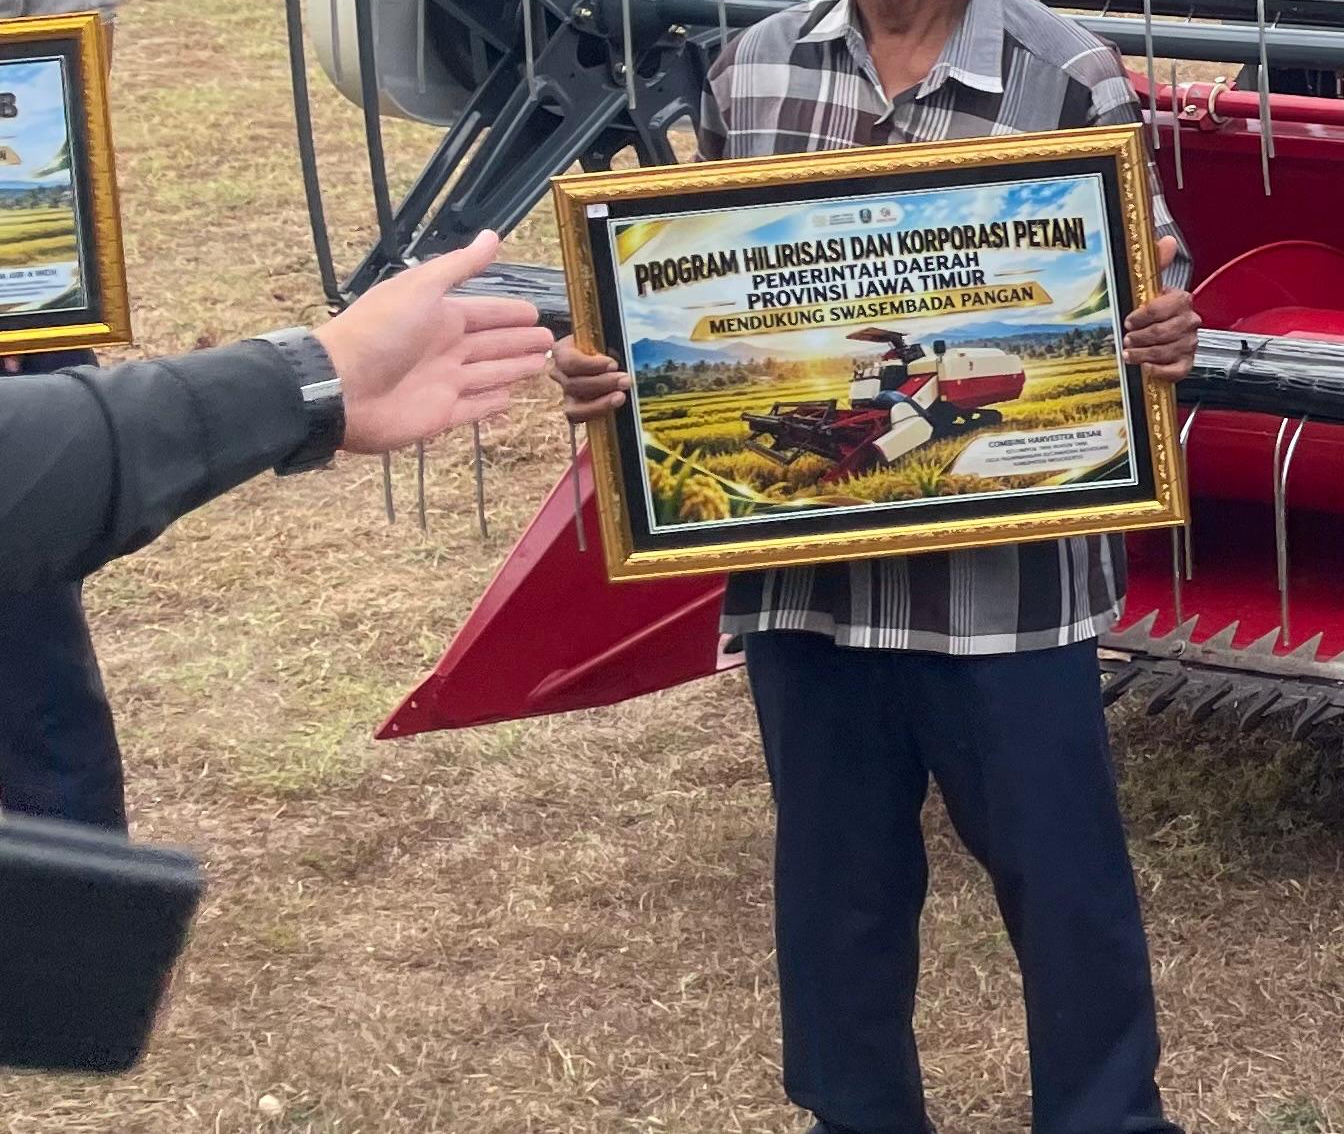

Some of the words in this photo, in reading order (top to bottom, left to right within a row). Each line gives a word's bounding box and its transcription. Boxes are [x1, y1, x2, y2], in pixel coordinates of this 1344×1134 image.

[635, 250, 736, 296] PROGRAM
[742, 236, 845, 277] HILIRISASI
[850, 232, 893, 264] DAN
[899, 221, 1009, 257] KORPORASI
[1014, 217, 1086, 249] PETANI
[752, 260, 887, 290] PEMERINTAH
[894, 251, 979, 277] DAERAH
[709, 308, 824, 335] MENDUKUNG
[830, 296, 955, 322] SWASEMBADA
[961, 286, 1034, 308] PANGAN
[747, 282, 849, 310] PROVINSI
[854, 275, 914, 299] JAWA
[918, 269, 985, 292] TIMUR
